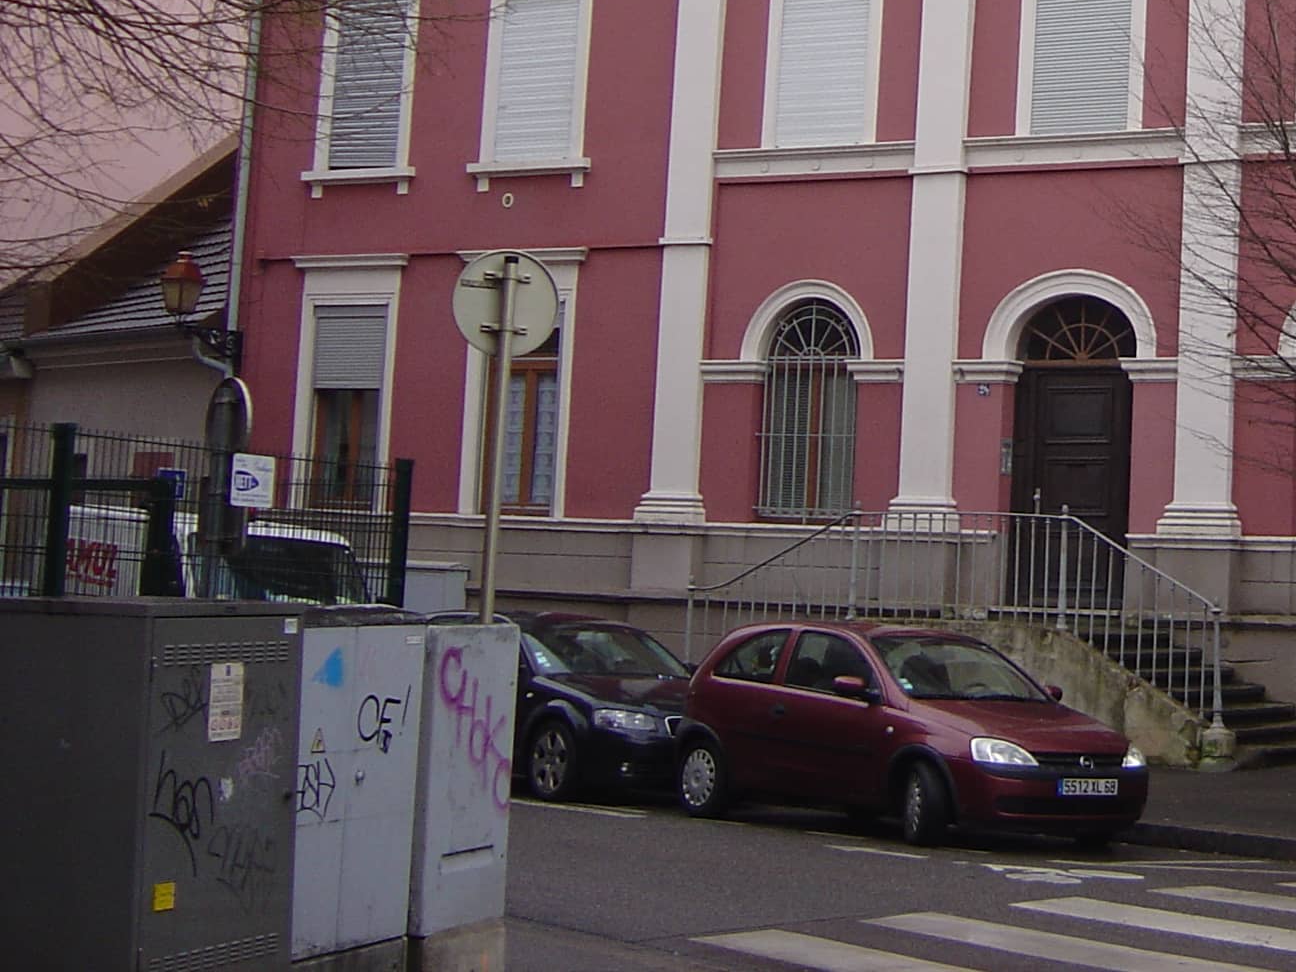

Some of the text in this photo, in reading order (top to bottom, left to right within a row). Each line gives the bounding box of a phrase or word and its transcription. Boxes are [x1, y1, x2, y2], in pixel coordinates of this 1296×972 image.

[1064, 780, 1116, 794] 5512 XL 68
